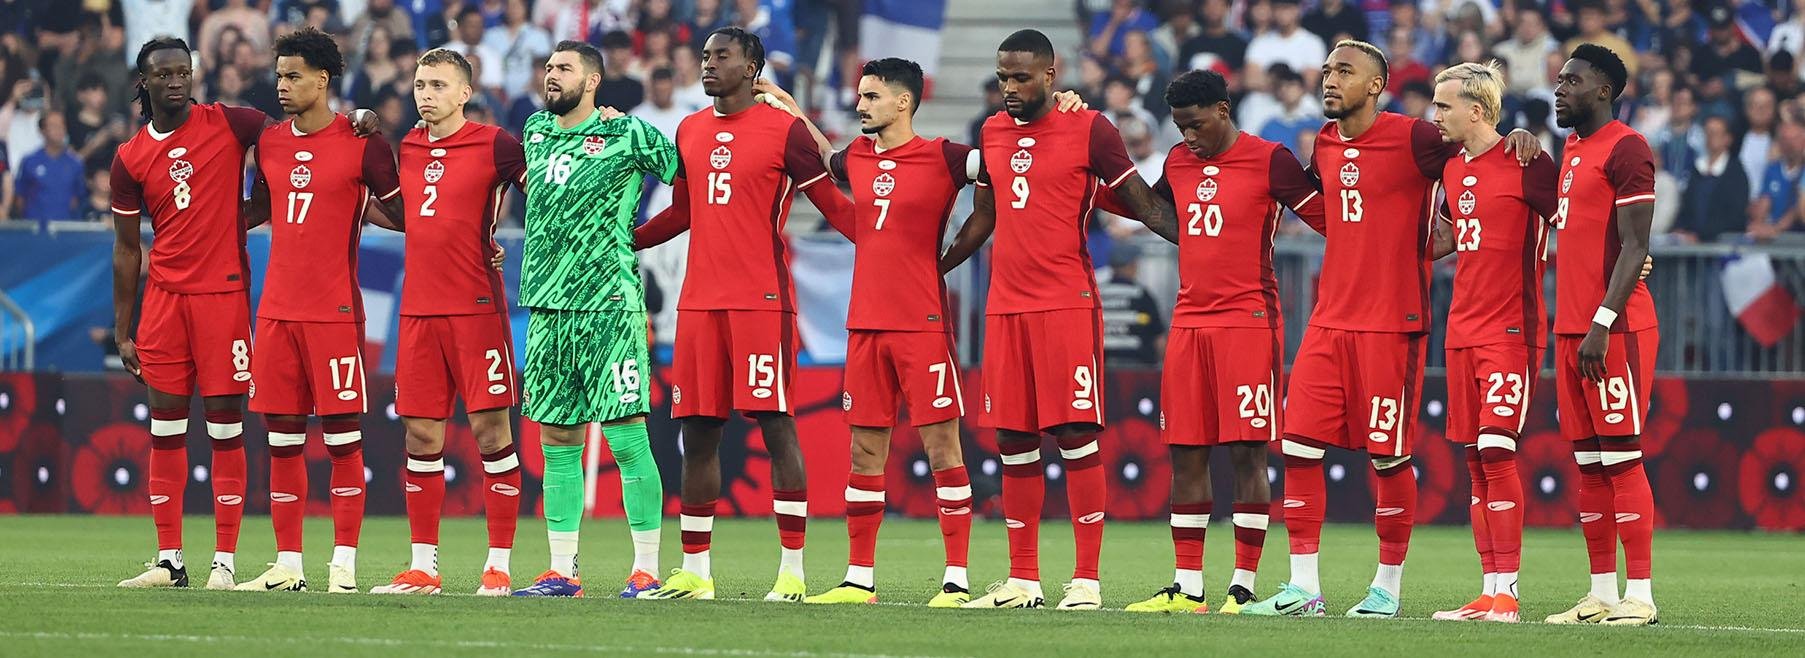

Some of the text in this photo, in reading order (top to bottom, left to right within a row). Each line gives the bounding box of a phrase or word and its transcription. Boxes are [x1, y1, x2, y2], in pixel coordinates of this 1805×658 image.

[172, 167, 191, 176] CANADA
[544, 153, 571, 185] 16
[174, 180, 191, 211] 8
[419, 185, 438, 216] 2
[707, 172, 732, 205] 15
[1011, 176, 1030, 209] 9
[287, 191, 314, 224] 17
[873, 198, 891, 230] 7
[1187, 203, 1224, 237] 20
[1340, 189, 1363, 222] 13
[1456, 218, 1482, 252] 23
[232, 339, 249, 371] 8
[485, 348, 504, 382] 2
[748, 354, 775, 387] 15
[329, 356, 356, 390] 17
[611, 359, 640, 392] 16
[929, 362, 946, 396] 7
[1074, 365, 1092, 398] 9
[1486, 372, 1523, 407] 23
[1236, 384, 1270, 418] 20
[1598, 376, 1629, 411] 19
[1369, 396, 1398, 431] 13
